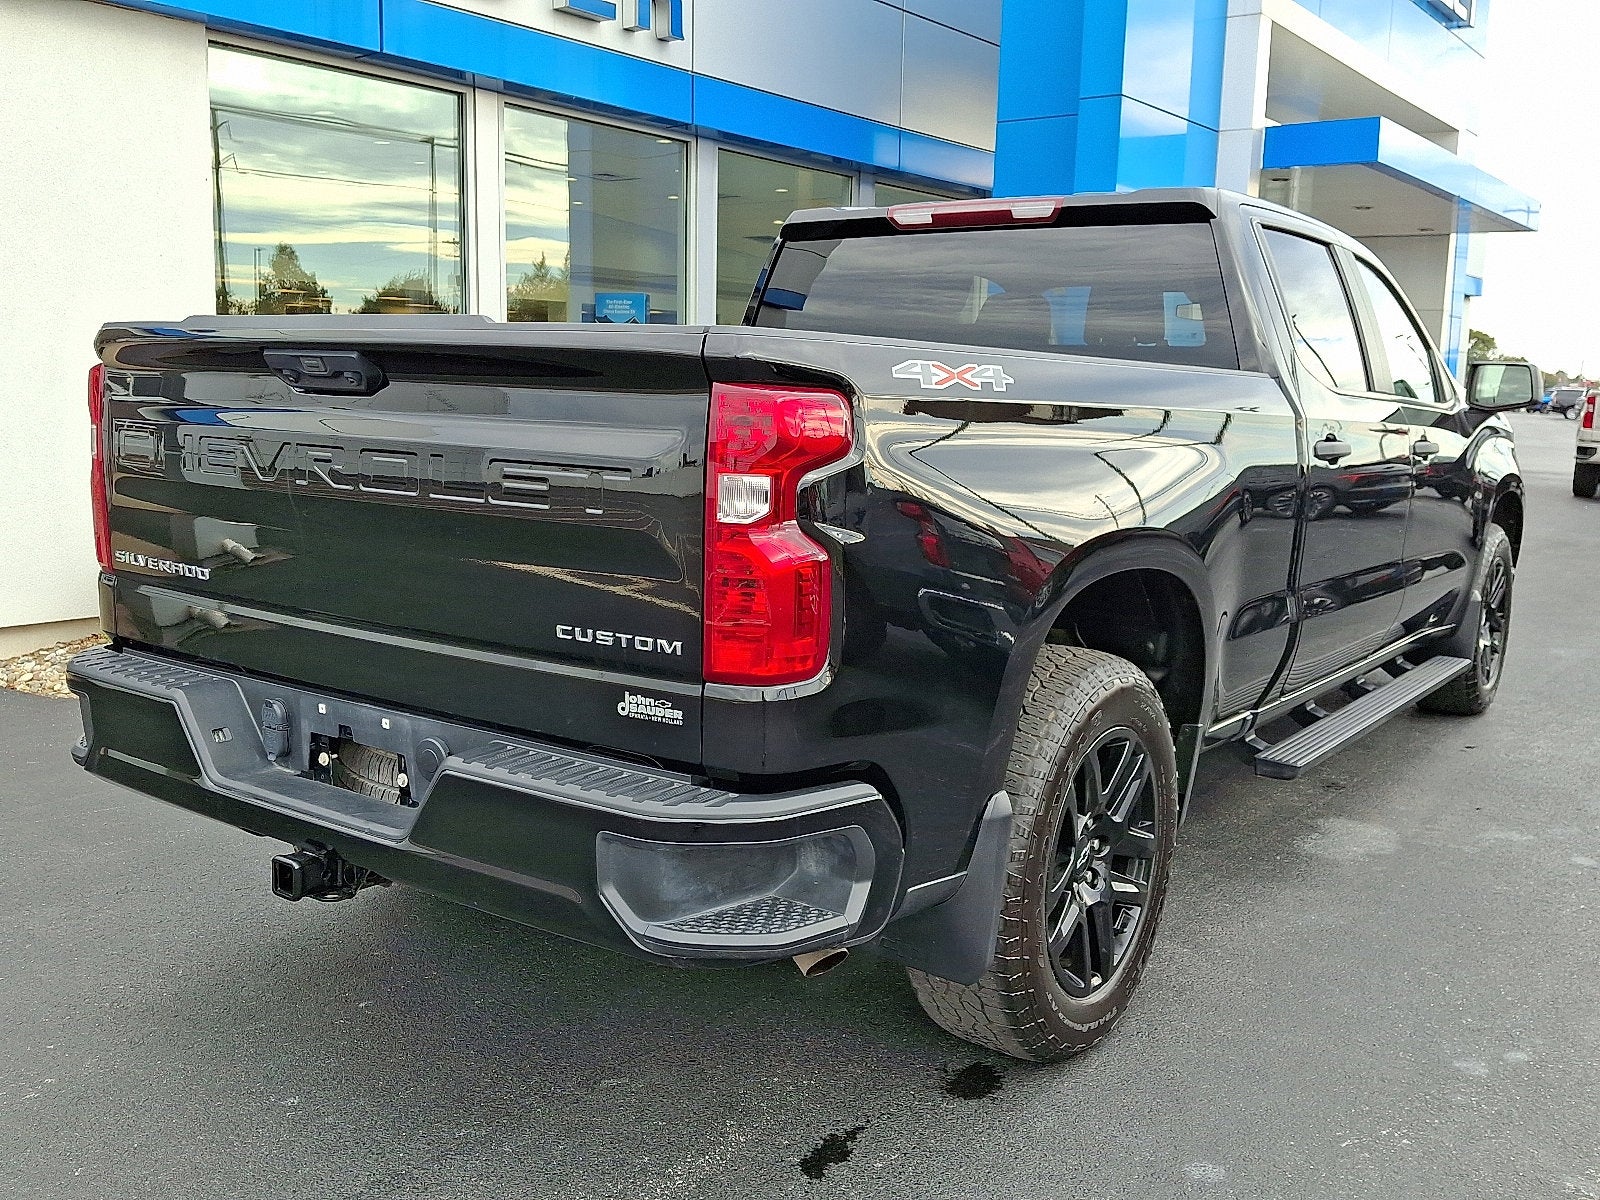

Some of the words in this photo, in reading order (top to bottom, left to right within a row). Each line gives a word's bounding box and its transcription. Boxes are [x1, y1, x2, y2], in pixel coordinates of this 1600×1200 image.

[113, 421, 632, 515] CHEVROLET
[115, 550, 211, 580] SILVERADO
[556, 624, 682, 655] CUSTOM
[617, 691, 655, 716] John
[629, 703, 684, 720] SAUDER
[662, 717, 684, 726] HOLLAND
